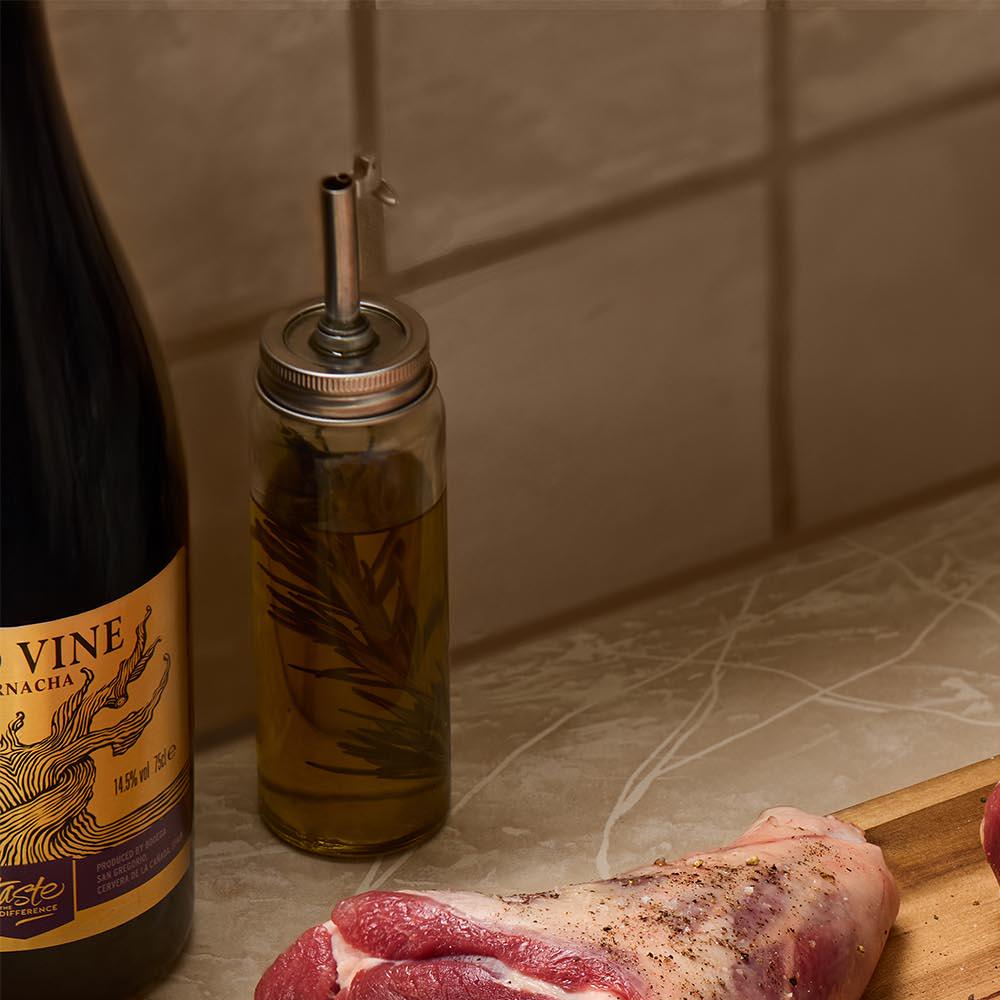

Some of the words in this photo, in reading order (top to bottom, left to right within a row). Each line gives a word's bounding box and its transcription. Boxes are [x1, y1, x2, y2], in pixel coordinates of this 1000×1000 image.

[17, 616, 124, 674] VINE
[113, 768, 138, 796] 14.5%
[139, 761, 150, 784] vol
[0, 903, 58, 917] DIFFERENCE
